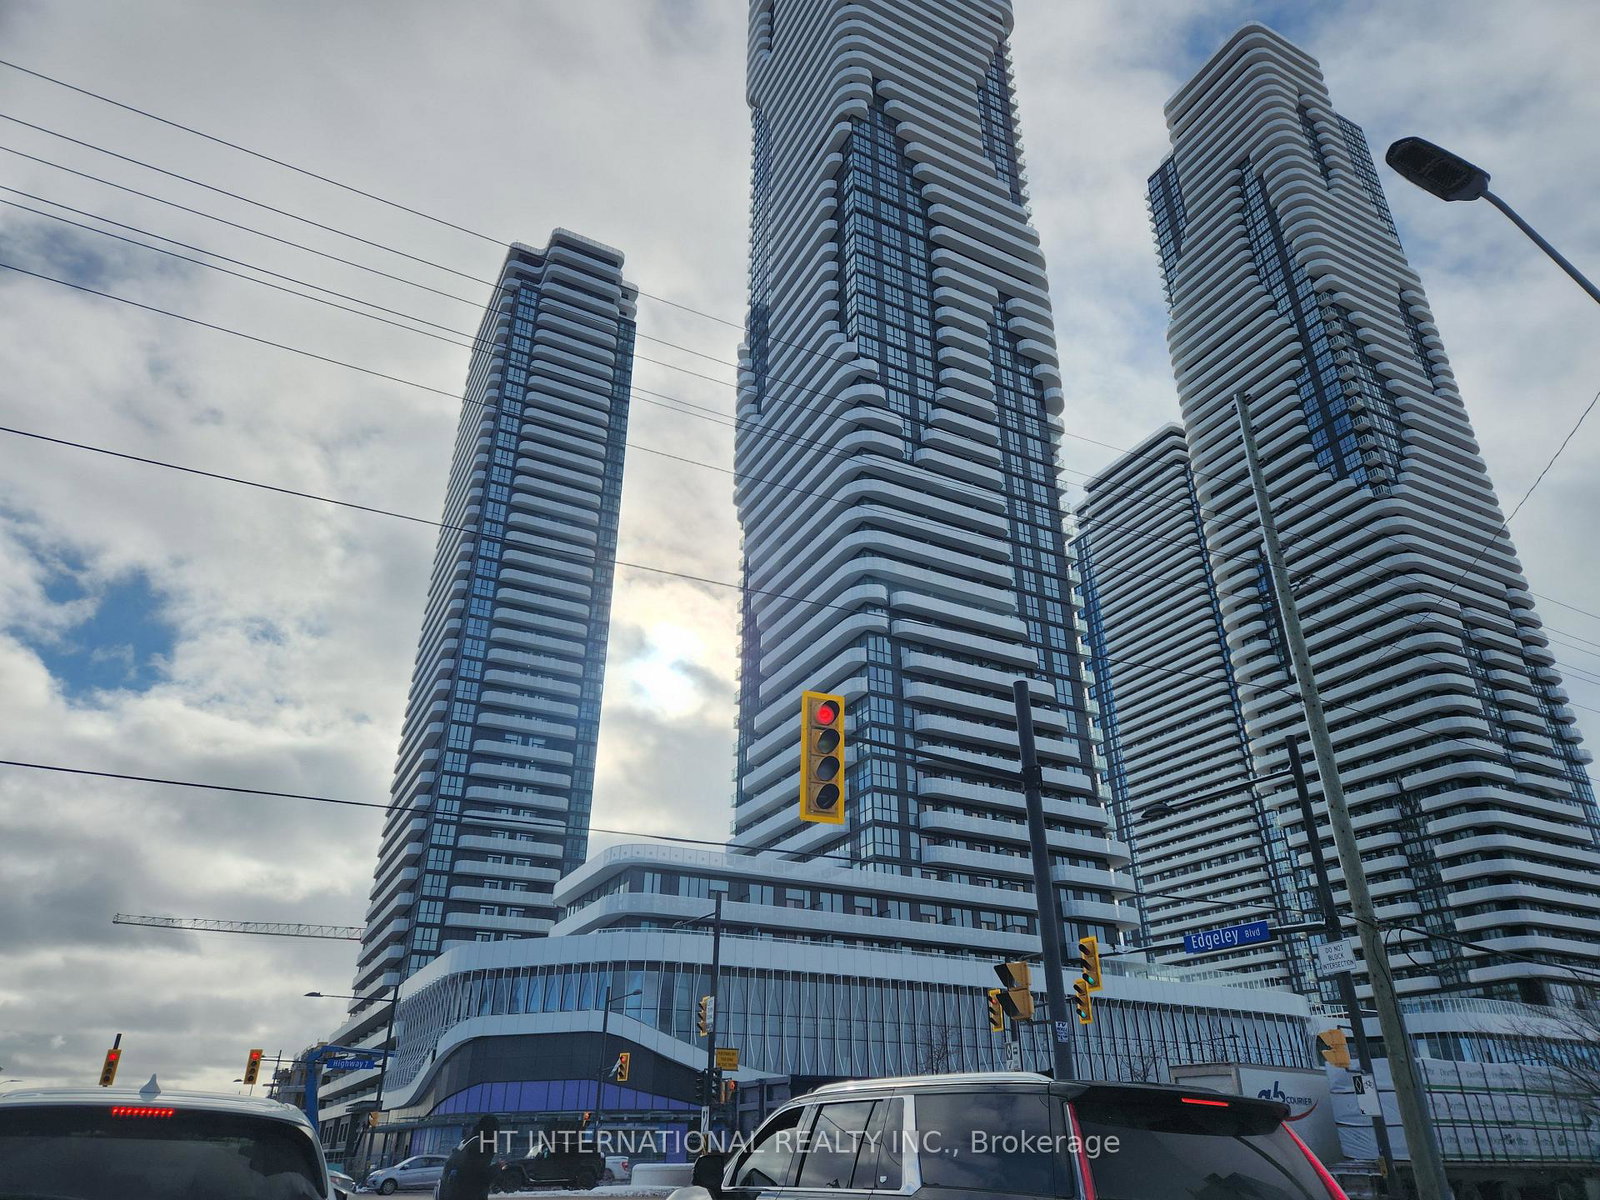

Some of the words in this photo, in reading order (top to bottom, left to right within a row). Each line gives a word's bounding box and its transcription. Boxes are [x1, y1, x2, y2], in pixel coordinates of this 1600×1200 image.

[1191, 929, 1238, 950] Edgeley
[1245, 928, 1260, 938] Blvd
[1328, 953, 1344, 961] BLOCK
[1322, 960, 1354, 970] INTERSECTION
[332, 1060, 363, 1069] Highway
[1286, 1096, 1312, 1105] COURIER
